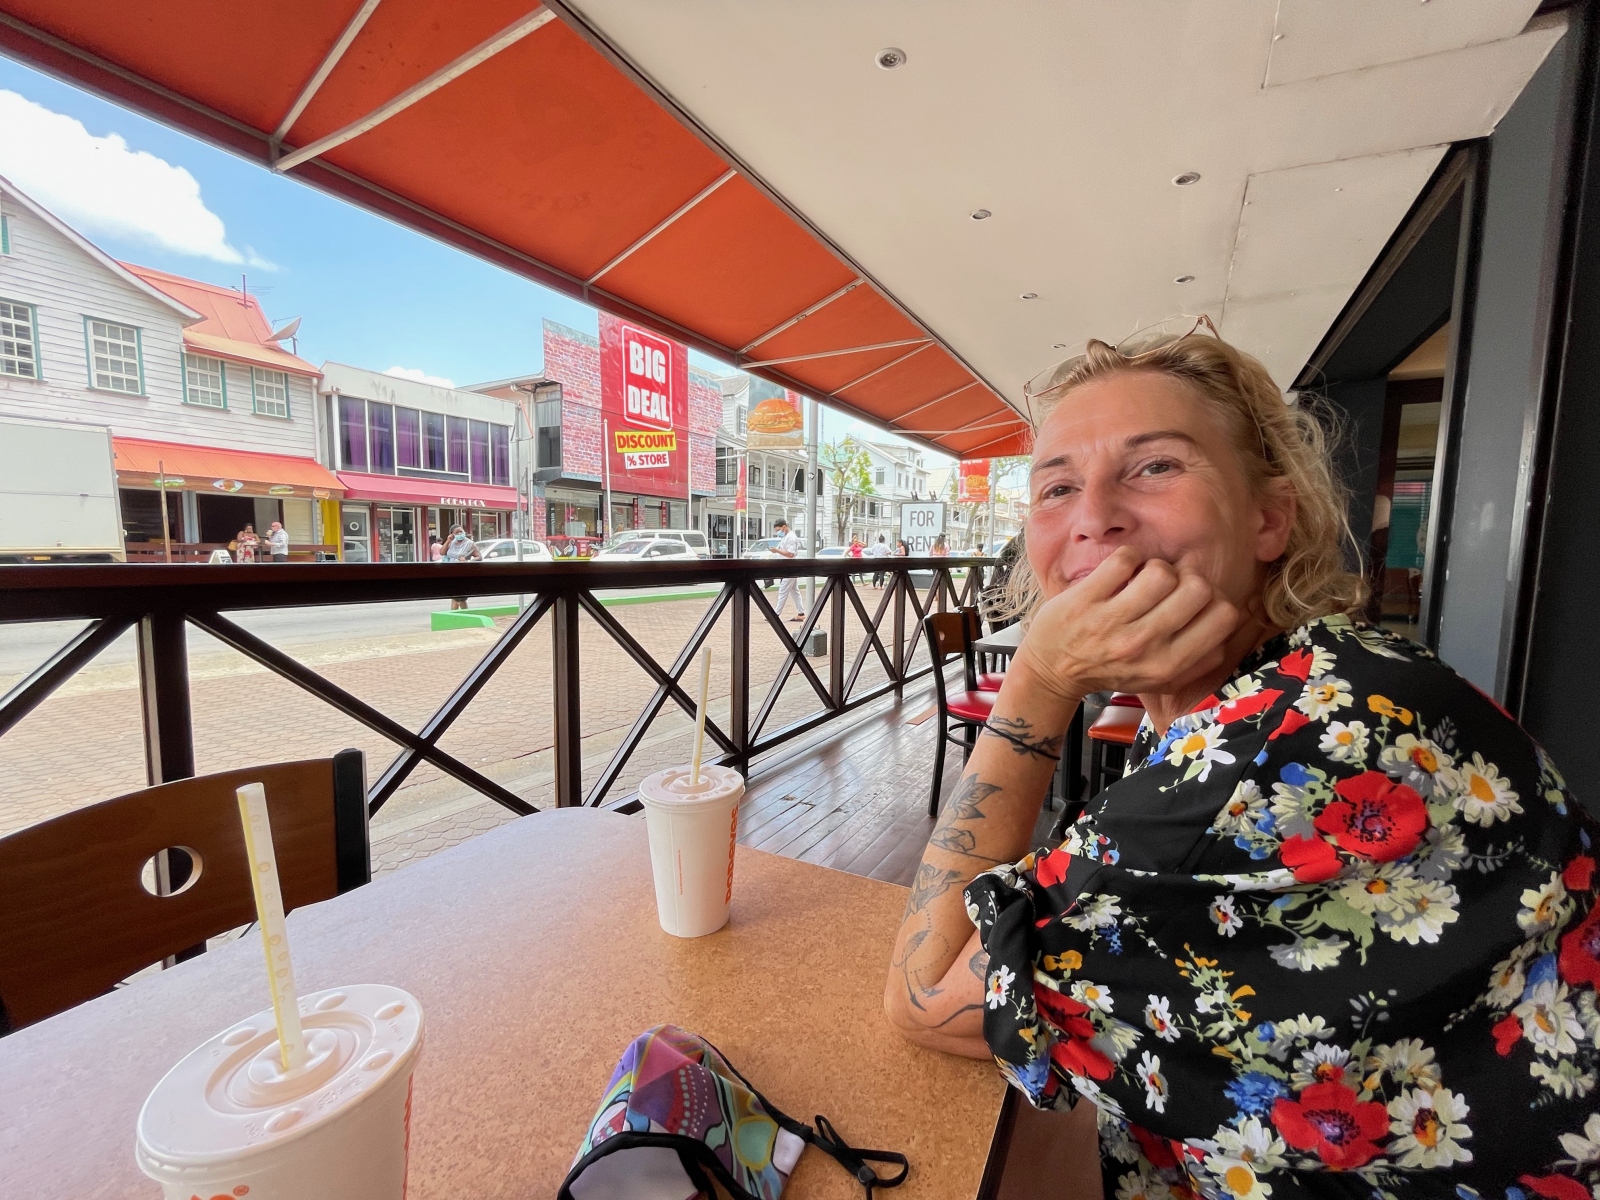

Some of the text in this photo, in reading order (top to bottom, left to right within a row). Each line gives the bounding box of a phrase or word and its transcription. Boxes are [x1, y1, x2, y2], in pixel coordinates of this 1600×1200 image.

[629, 341, 666, 384] BIG
[628, 386, 670, 423] DEAL
[617, 434, 674, 449] DISCOUNT
[638, 454, 668, 466] STORE
[910, 510, 935, 527] FOR
